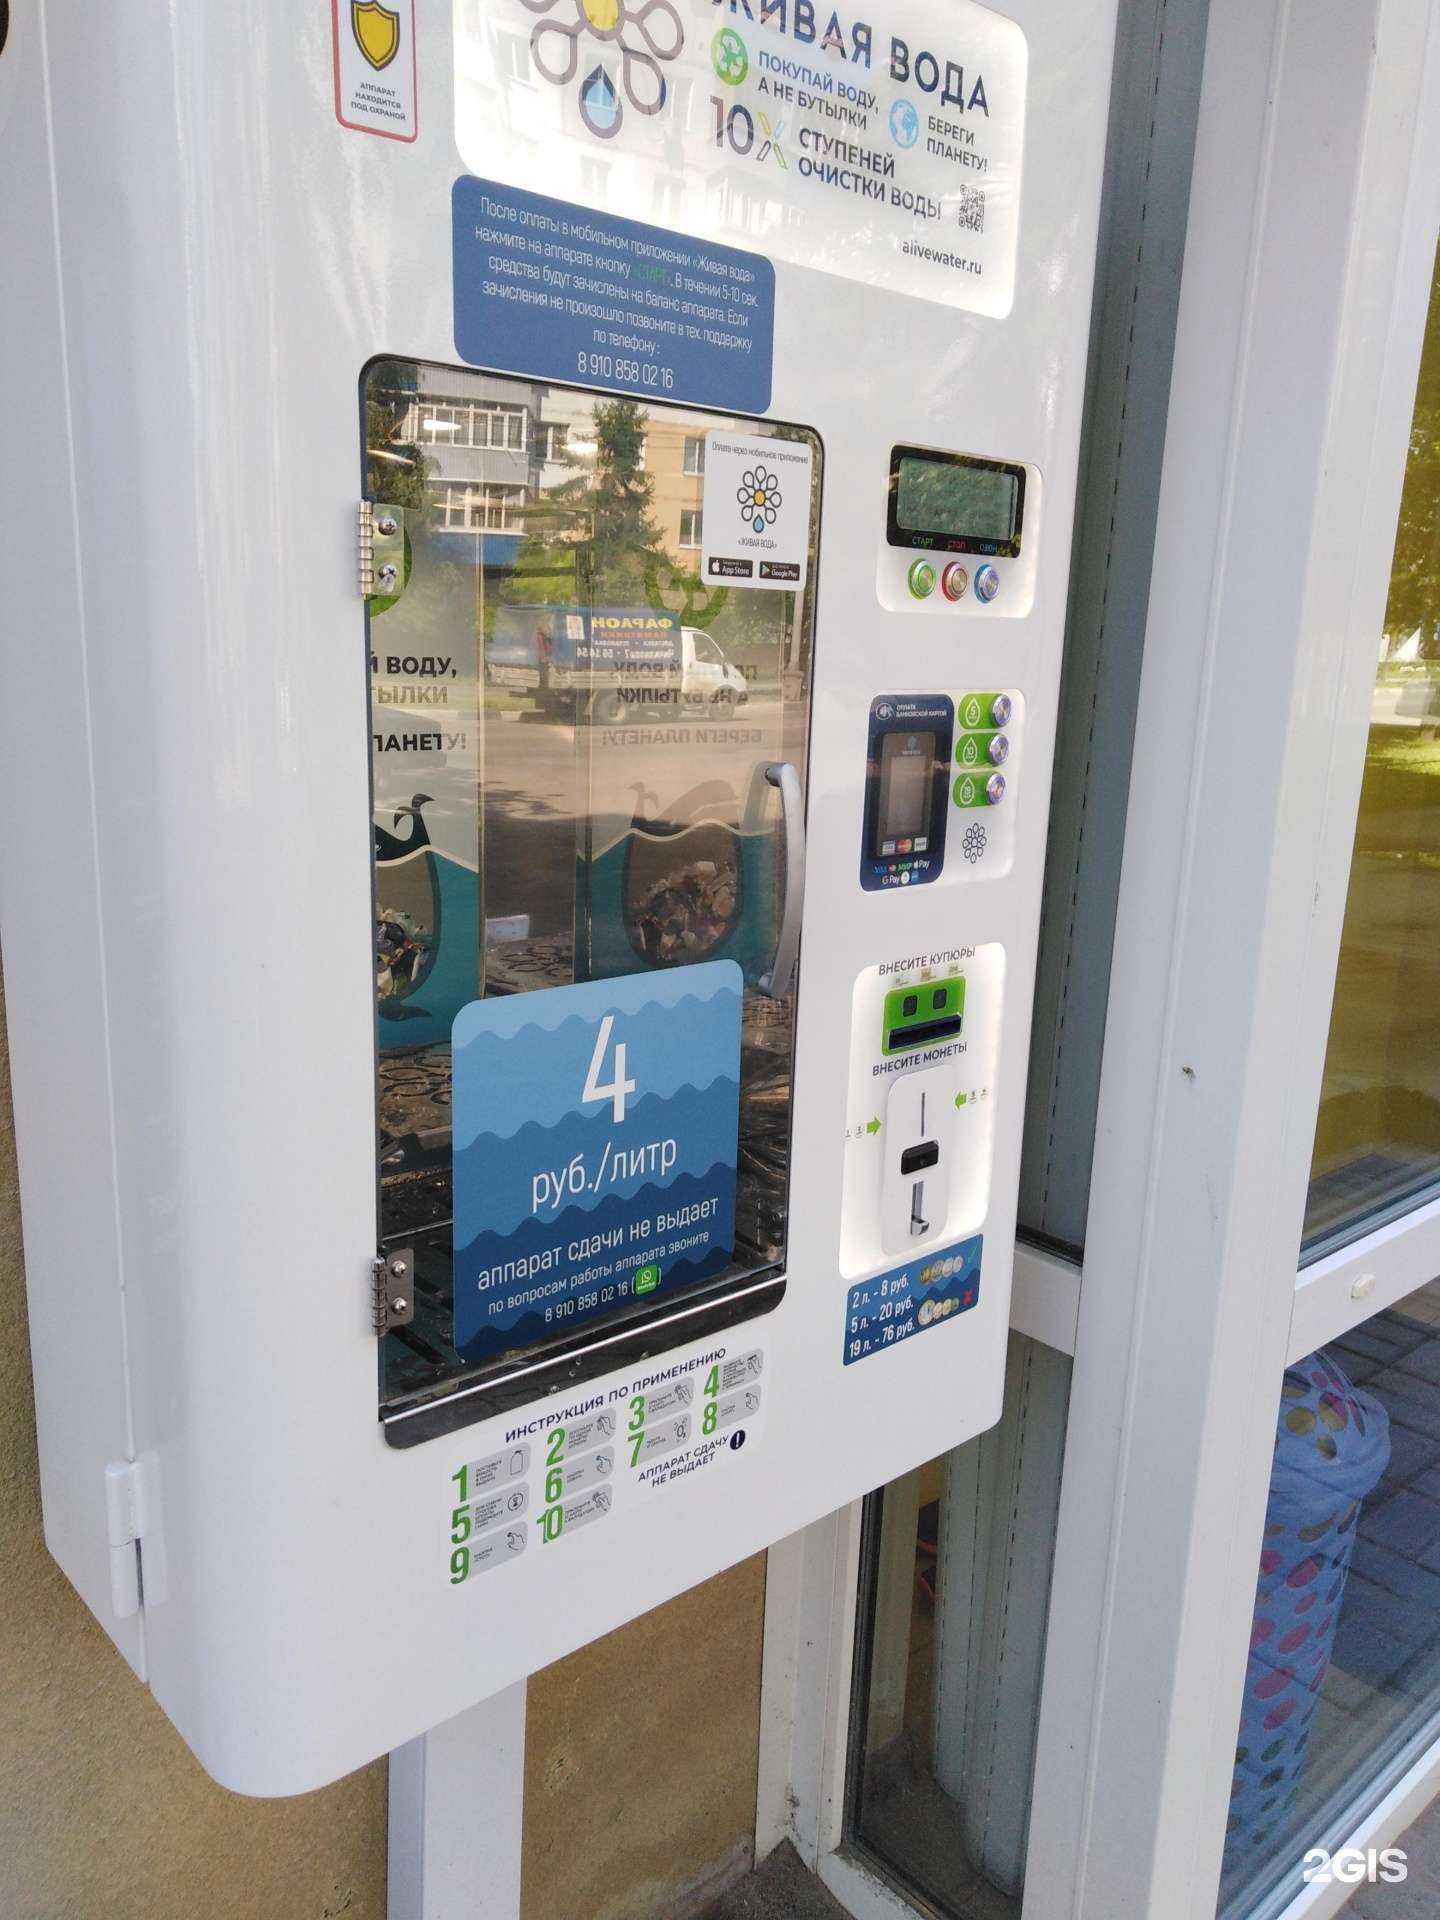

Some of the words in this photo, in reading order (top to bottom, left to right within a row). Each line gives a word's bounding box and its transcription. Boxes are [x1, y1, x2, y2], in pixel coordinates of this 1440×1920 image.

[360, 81, 397, 98] АППАРАТ
[758, 51, 834, 94] ПОКУПАЙ
[837, 81, 879, 114] ВОДУ,
[889, 36, 990, 118] ВОДА
[350, 101, 369, 113] ПОД
[369, 104, 406, 121] ОХРАНОЙ
[354, 91, 402, 110] НАХОДИТСЯ
[758, 77, 769, 95] А
[773, 82, 793, 103] НЕ
[797, 90, 867, 130] БУТЫЛКИ
[928, 115, 975, 147] БЕРЕГИ
[799, 127, 895, 178] СТУПЕНЕЙ
[926, 138, 988, 173] ПЛАНЕТУ!
[798, 156, 886, 202] ОЧИСТКИ
[480, 196, 517, 222] После
[519, 210, 560, 232] оплаты
[562, 222, 569, 235] в
[570, 224, 628, 250] мобильном
[630, 239, 691, 266] приложении
[475, 226, 526, 250] нажмите
[528, 239, 542, 255] на
[544, 243, 593, 266] аппарате
[595, 256, 631, 279] кнопку
[675, 272, 682, 288] В
[683, 277, 721, 299] течении
[722, 284, 740, 303] 5-10
[902, 240, 982, 276] alivewater.ru
[488, 256, 540, 280] средства
[542, 265, 572, 289] будут
[572, 275, 630, 300] зачислены
[631, 289, 644, 304] на
[645, 289, 681, 312] баланс
[727, 309, 749, 327] Если
[482, 280, 548, 306] зачисления
[550, 296, 563, 310] не
[565, 298, 624, 324] произошло
[626, 312, 676, 335] позвоните
[678, 324, 683, 336] в
[703, 329, 752, 354] поддержку
[593, 329, 607, 344] по
[577, 351, 586, 374] 8
[590, 354, 612, 378] 910
[615, 358, 640, 382] 858
[642, 363, 658, 386] 02
[660, 367, 674, 389] 16
[722, 566, 734, 575] App
[735, 567, 750, 576] Store
[771, 568, 788, 578] Google
[387, 656, 457, 679] ВОДУ,
[878, 955, 927, 976] ВНЕСИТЕ
[930, 946, 976, 965] КУПЮРЫ
[582, 1015, 636, 1123] 4
[872, 1054, 921, 1076] ВНЕСИТЕ
[923, 1041, 968, 1063] МОНЕТЫ
[531, 1138, 677, 1214] руб./литр
[477, 1246, 562, 1291] аппарат
[568, 1227, 623, 1261] сдачи
[630, 1218, 650, 1240] не
[656, 1197, 719, 1234] выдает
[488, 1299, 504, 1316] по
[507, 1279, 567, 1310] вопросам
[570, 1265, 613, 1291] работы
[615, 1245, 666, 1273] аппарата
[669, 1231, 709, 1255] звоните
[852, 1291, 860, 1309] 2
[861, 1292, 870, 1306] л.
[881, 1280, 888, 1296] 8
[890, 1273, 910, 1295] руб.
[544, 1307, 552, 1323] 8
[556, 1300, 575, 1319] 910
[578, 1292, 598, 1311] 858
[601, 1287, 614, 1303] 02
[617, 1281, 628, 1297] 16
[851, 1317, 858, 1333] 5
[859, 1318, 869, 1330] л.
[879, 1302, 893, 1322] 20
[894, 1296, 914, 1317] руб.
[849, 1339, 861, 1358] 19
[862, 1340, 872, 1352] л.
[882, 1324, 894, 1344] 76
[896, 1318, 915, 1340] руб.
[504, 1393, 604, 1444] ИНСТРУКЦИЯ
[608, 1386, 629, 1403] ПО
[632, 1347, 727, 1394] ПРИМЕНЕНИЮ
[703, 1364, 719, 1399] 4
[628, 1395, 647, 1432] 3
[702, 1401, 719, 1436] 8
[545, 1427, 567, 1467] 2
[627, 1430, 646, 1468] 7
[638, 1451, 691, 1482] АППАРАТ
[693, 1435, 730, 1458] СДАЧУ
[451, 1464, 468, 1503] 1
[545, 1467, 565, 1504] 6
[651, 1474, 667, 1488] НЕ
[669, 1452, 716, 1480] ВЫДАЕТ
[451, 1504, 471, 1545] 5
[536, 1504, 564, 1545] 10
[450, 1546, 470, 1585] 9
